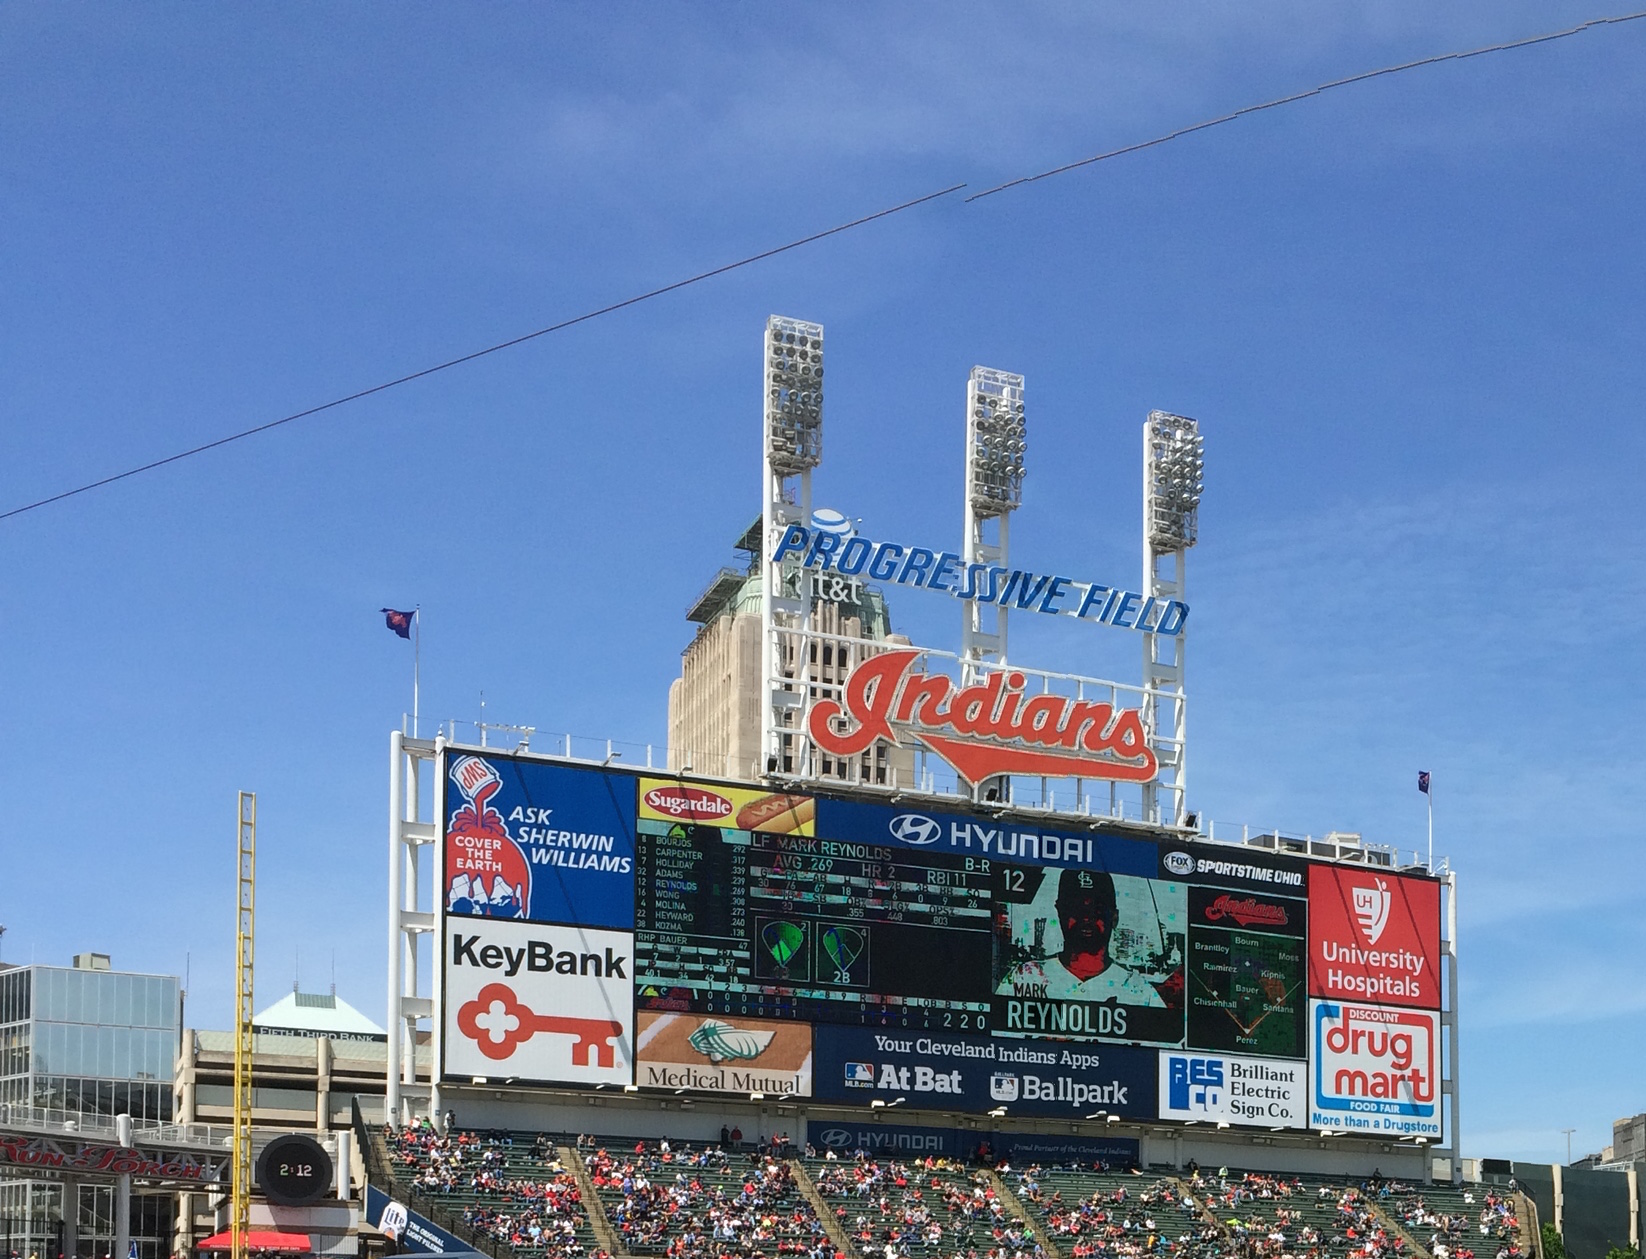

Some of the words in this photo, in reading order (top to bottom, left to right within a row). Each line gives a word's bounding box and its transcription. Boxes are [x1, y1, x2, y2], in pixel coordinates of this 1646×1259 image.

[772, 524, 1074, 616] PROGRESSIVE
[1077, 583, 1191, 637] FIELD
[807, 648, 1159, 787] Indians
[648, 788, 731, 815] Sugardale
[508, 806, 553, 826] ASK
[455, 836, 502, 850] COVER
[517, 827, 615, 853] SHERWIN
[655, 837, 692, 848] BOURJOS
[951, 822, 1093, 864] HYUNDAI
[466, 848, 493, 861] THE
[531, 848, 632, 874] WILLIAMS
[655, 848, 703, 860] CARPENTER
[752, 833, 770, 847] LF
[778, 837, 817, 853] MARK
[821, 841, 893, 860] REYNOLDS
[965, 857, 991, 872] B-R
[774, 855, 803, 869] AVG
[456, 858, 502, 872] EARTH
[655, 858, 694, 870] HOLLIDAY
[655, 869, 683, 879] ADAMS
[1171, 855, 1189, 867] FOX
[1197, 859, 1273, 881] SPORTSTIME
[1274, 870, 1303, 887] OHIO
[655, 879, 697, 891] REYNOLDS
[1002, 869, 1026, 892] 12
[655, 889, 680, 900] WONG
[655, 900, 686, 911] MOLINA
[655, 910, 694, 922] HEYWARD
[655, 921, 683, 932] KOZMA
[660, 935, 687, 945] BAUER
[453, 934, 627, 979] KeyBank
[1322, 941, 1426, 977] University
[1014, 982, 1048, 998] MARK
[1327, 968, 1421, 998] Hospitals
[1007, 1001, 1128, 1035] REYNOLDS
[1349, 1009, 1400, 1023] DISCOUNT
[259, 1027, 295, 1037] FIFTH
[340, 1032, 375, 1043] BANK
[1326, 1010, 1414, 1071] drug
[875, 1035, 913, 1054] Your
[916, 1038, 996, 1060] Cleveland
[1062, 1051, 1100, 1069] Apps
[648, 1066, 725, 1090] Medical
[731, 1071, 801, 1094] Mutual
[844, 1080, 874, 1089] MLB.com
[878, 1064, 911, 1091] At
[914, 1066, 963, 1094] Bat
[1230, 1063, 1295, 1083] Brilliant
[1023, 1075, 1128, 1107] Ballpark
[1230, 1081, 1291, 1101] Electric
[1335, 1068, 1435, 1104] mart
[1230, 1099, 1265, 1119] Sign
[1268, 1103, 1293, 1119] Co.
[1350, 1101, 1378, 1113] FOOD
[1379, 1103, 1401, 1114] FAIR
[1312, 1112, 1341, 1127] More
[1343, 1115, 1370, 1129] than
[1372, 1119, 1381, 1130] a
[1383, 1117, 1439, 1134] Drugstore
[857, 1131, 943, 1151] HYUNDAI
[280, 1163, 313, 1178] 2:12
[420, 1226, 444, 1248] ORIGINAL
